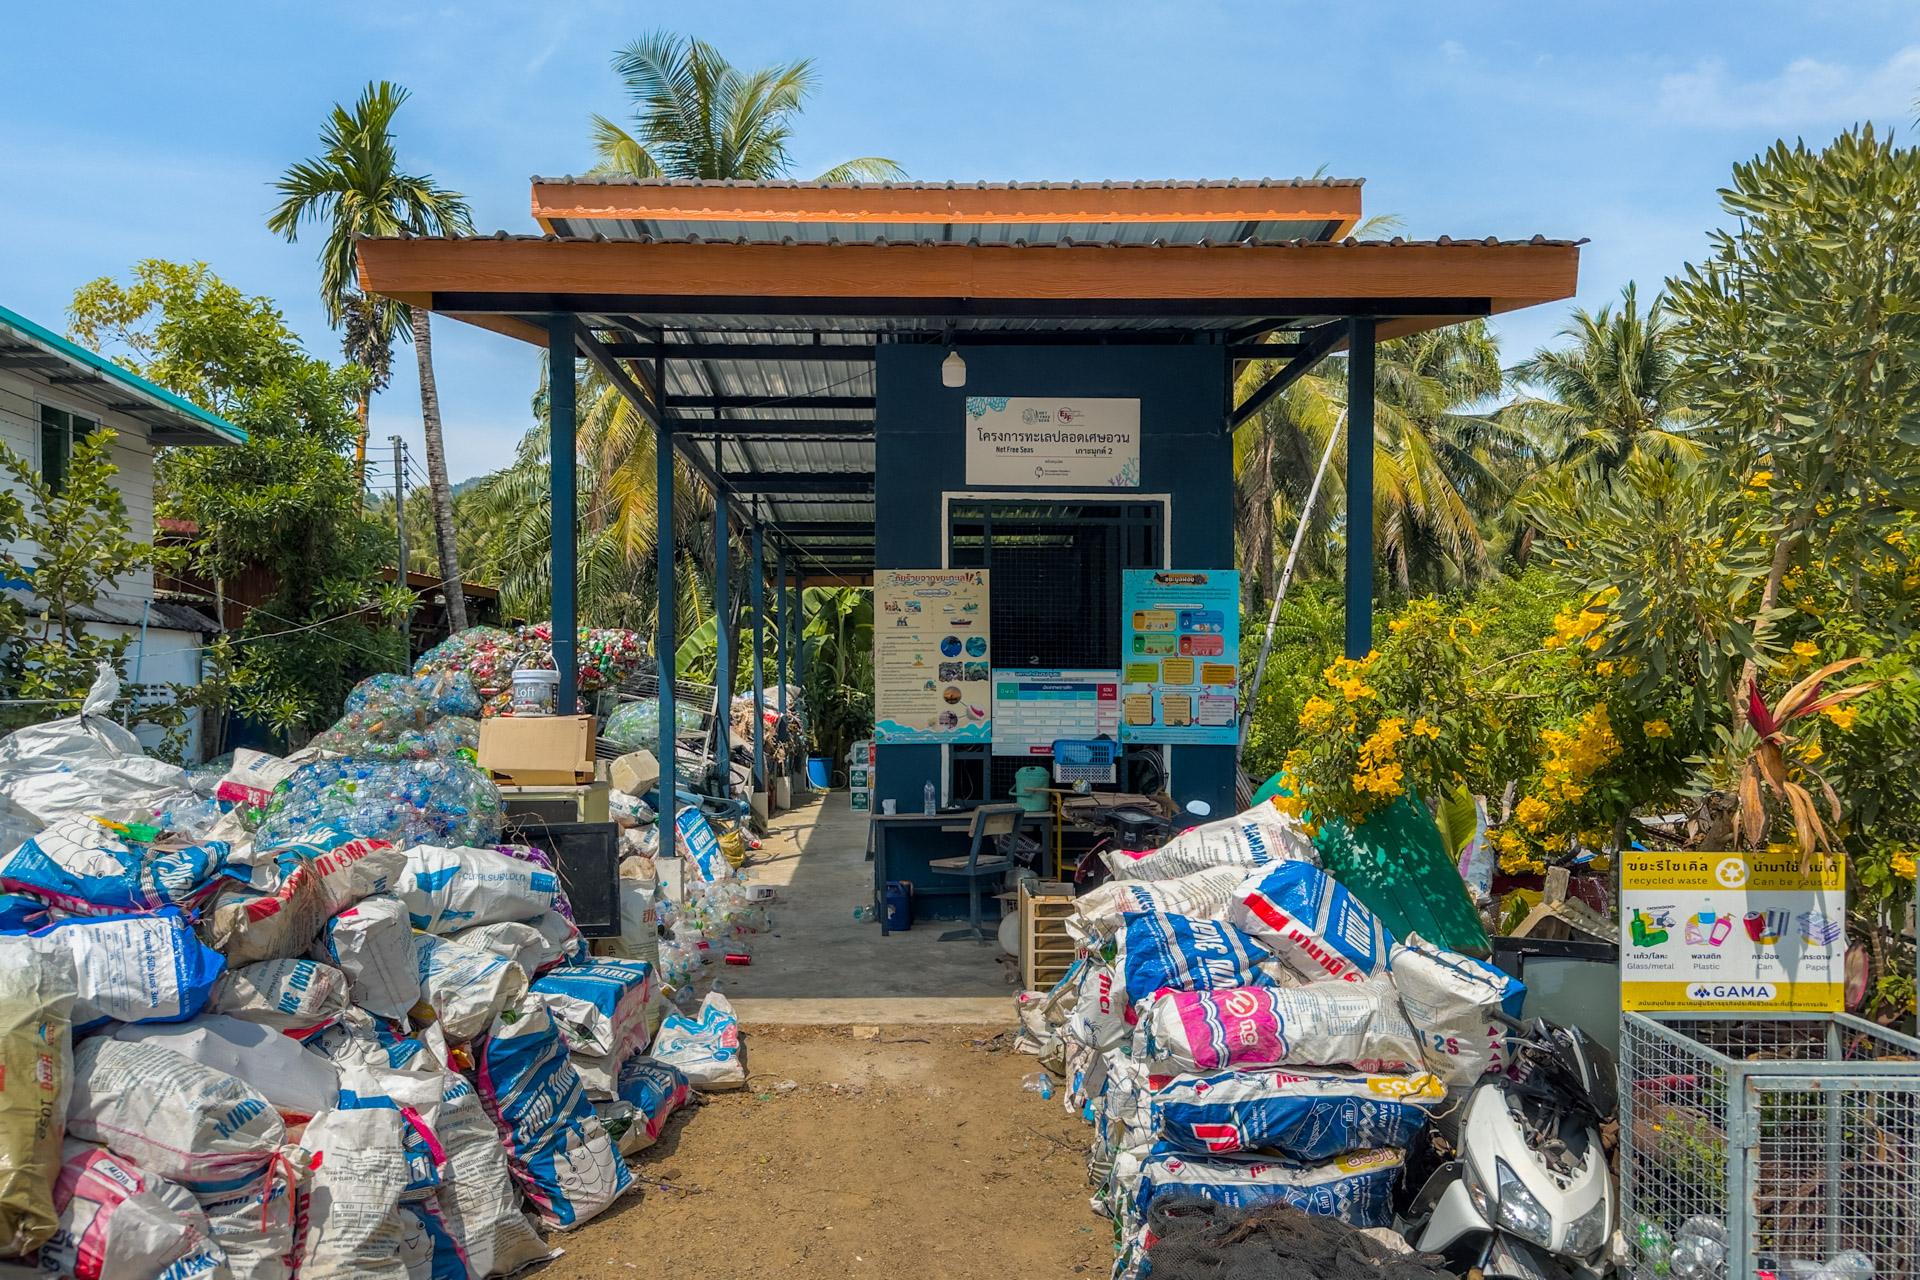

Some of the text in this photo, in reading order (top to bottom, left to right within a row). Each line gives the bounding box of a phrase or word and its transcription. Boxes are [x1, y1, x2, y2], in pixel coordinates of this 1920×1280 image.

[977, 427, 1130, 443] โครงการทะเลปลอดเศษอวน
[1627, 859, 1708, 872] ขยะรีไซเคิล
[1629, 877, 1708, 886] recycled waste
[1753, 878, 1774, 886] Can
[1780, 878, 1793, 886] be
[1633, 952, 1668, 960] แก้ว/โลหะ
[1752, 952, 1780, 960] กระป๋อง
[1627, 962, 1674, 970] Glass/metal
[1693, 962, 1720, 970] Plastic
[1805, 963, 1830, 971] Paper
[1713, 985, 1770, 998] GAMA
[1350, 1178, 1360, 1204] WAVE
